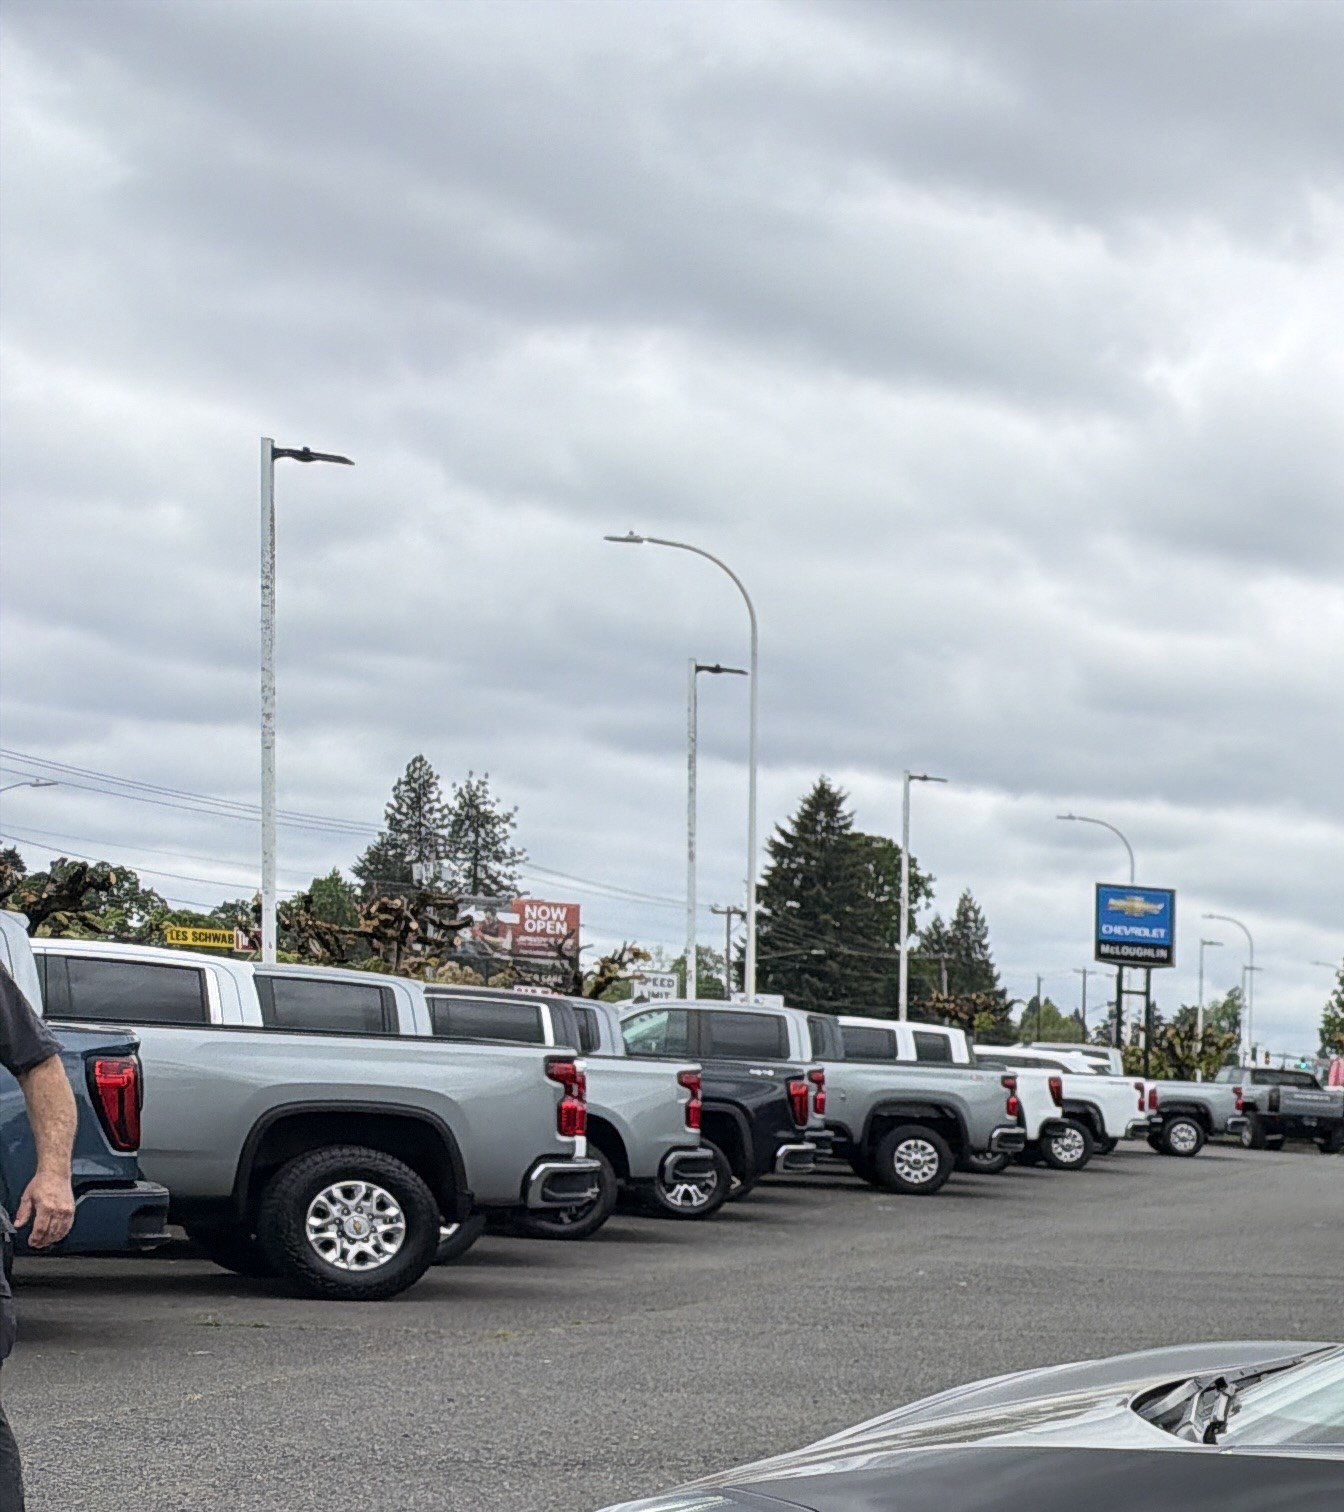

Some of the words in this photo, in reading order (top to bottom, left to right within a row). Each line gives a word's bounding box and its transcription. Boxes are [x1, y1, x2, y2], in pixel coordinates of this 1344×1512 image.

[525, 904, 567, 921] NOW
[525, 920, 568, 936] OPEN
[1102, 924, 1166, 938] CHEVROLET
[170, 929, 188, 941] LES
[192, 931, 235, 945] SCHWAB
